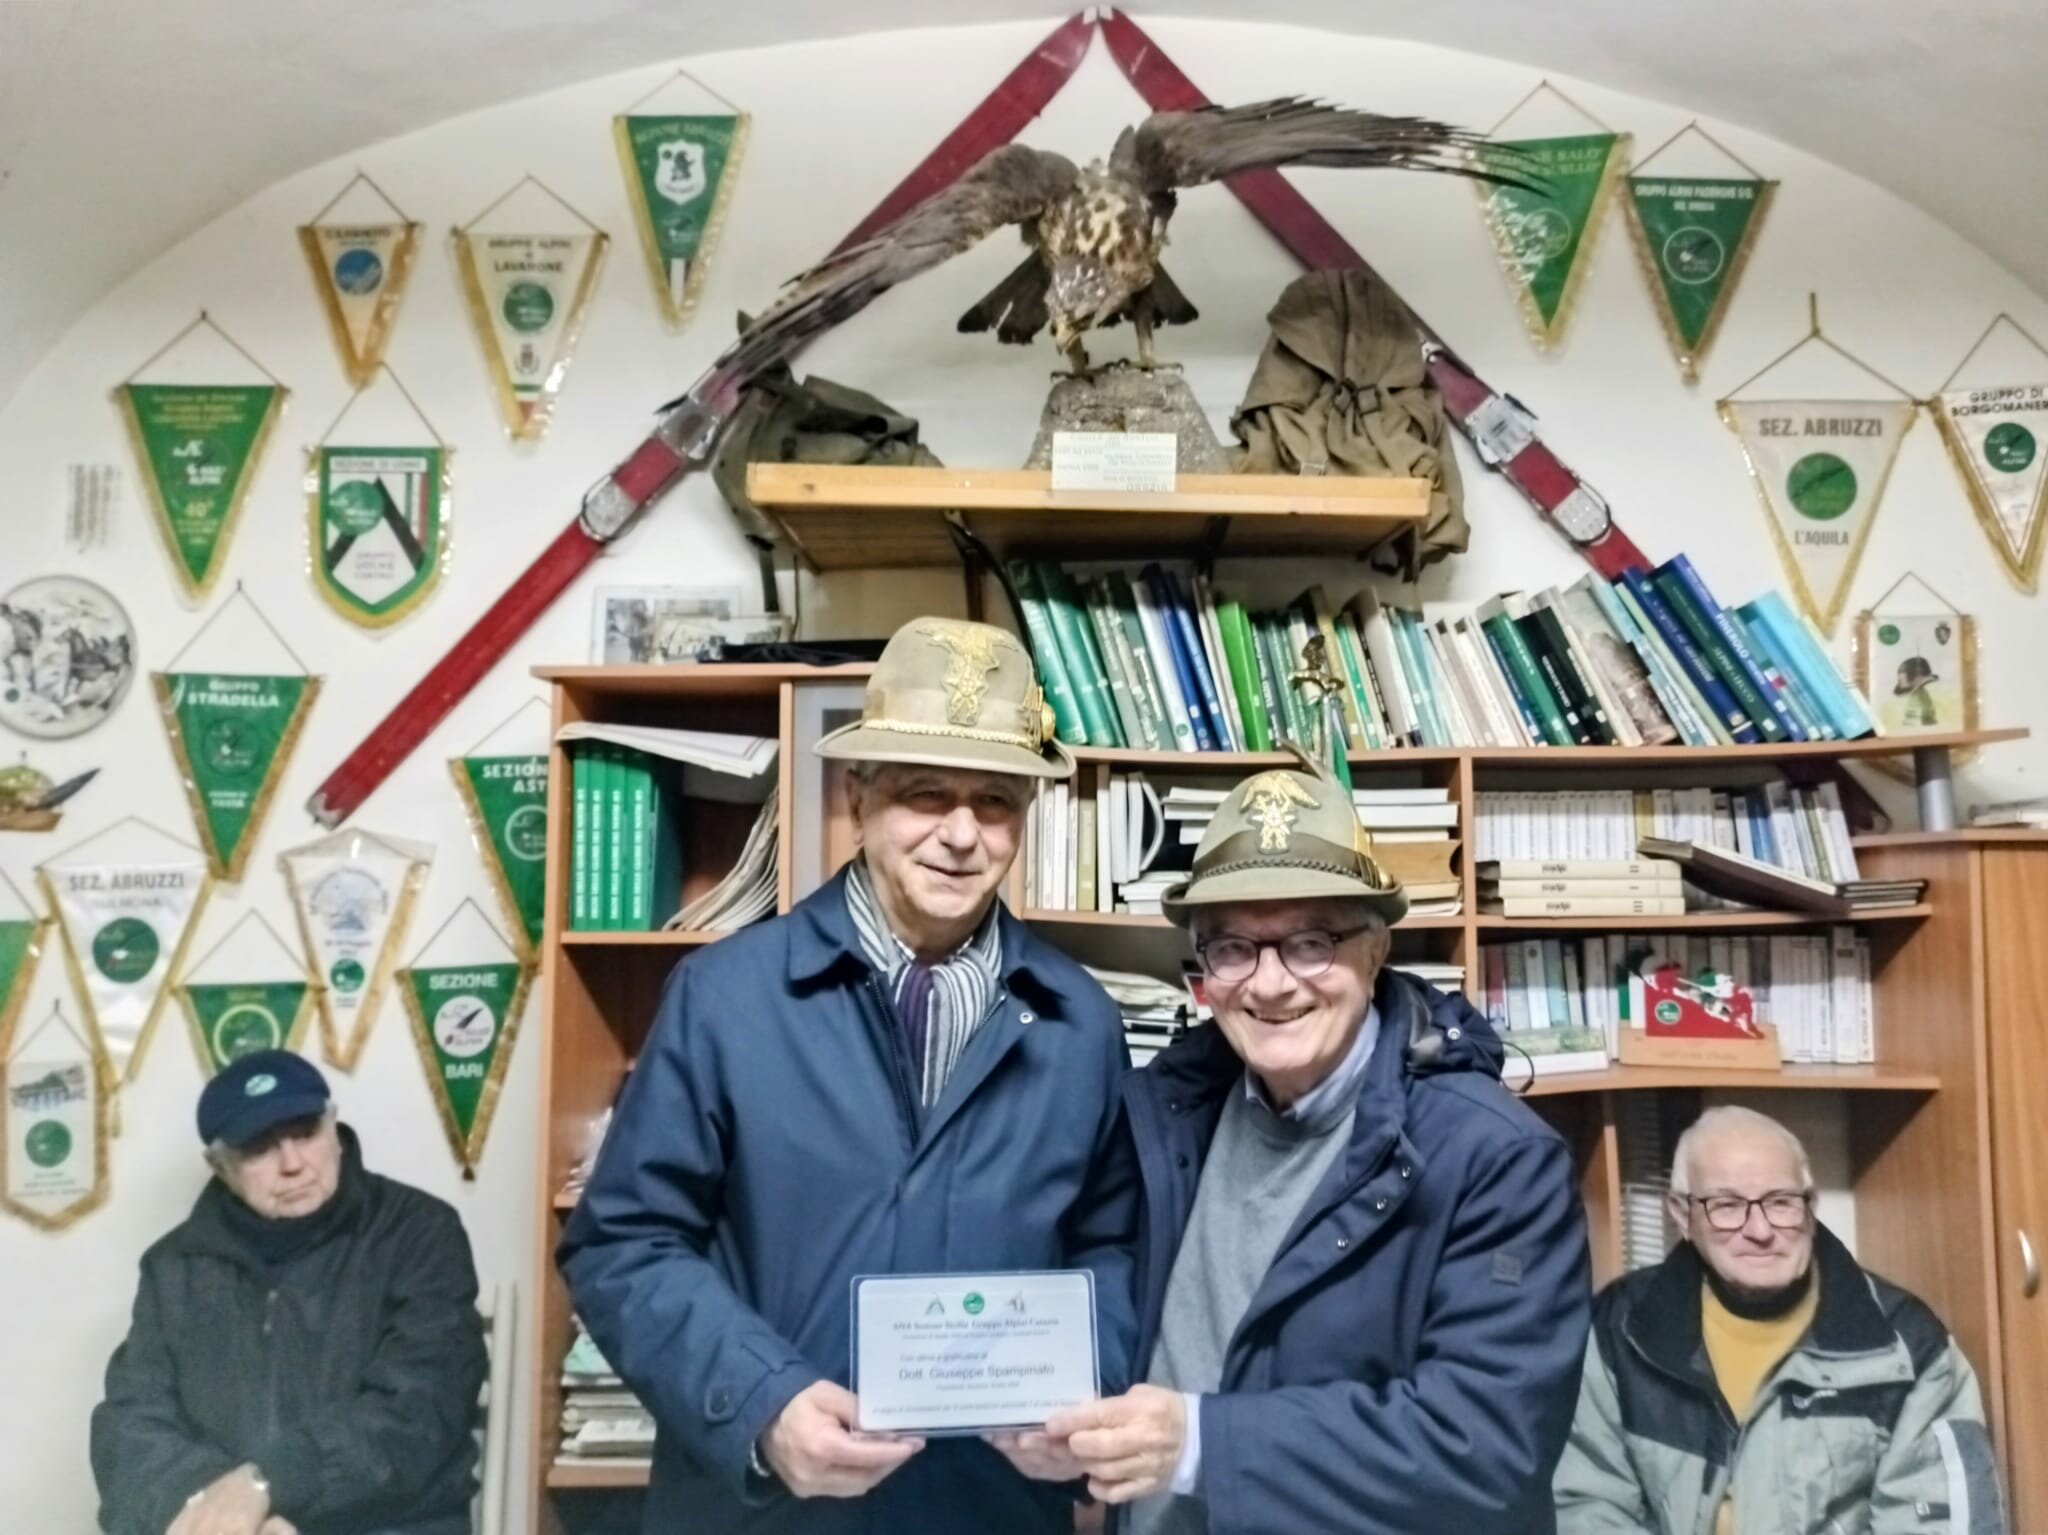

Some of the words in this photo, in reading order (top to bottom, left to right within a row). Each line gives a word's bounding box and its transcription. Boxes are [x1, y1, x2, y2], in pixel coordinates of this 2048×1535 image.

[494, 261, 562, 273] LAVARONE
[1969, 387, 2025, 403] GRUPPO
[2030, 387, 2044, 399] DI
[1758, 417, 1799, 438] SEZ.
[1803, 417, 1883, 438] ABRUZZI
[1794, 530, 1850, 546] L'AQUILA
[187, 691, 280, 708] STRADELLA
[69, 875, 105, 892] SEZ.
[111, 872, 185, 890] ABRUZZI
[429, 971, 499, 991] SEZIONE
[445, 1062, 485, 1080] BARI
[928, 1366, 984, 1381] Giuseppe
[987, 1363, 1055, 1379] Spampinato
